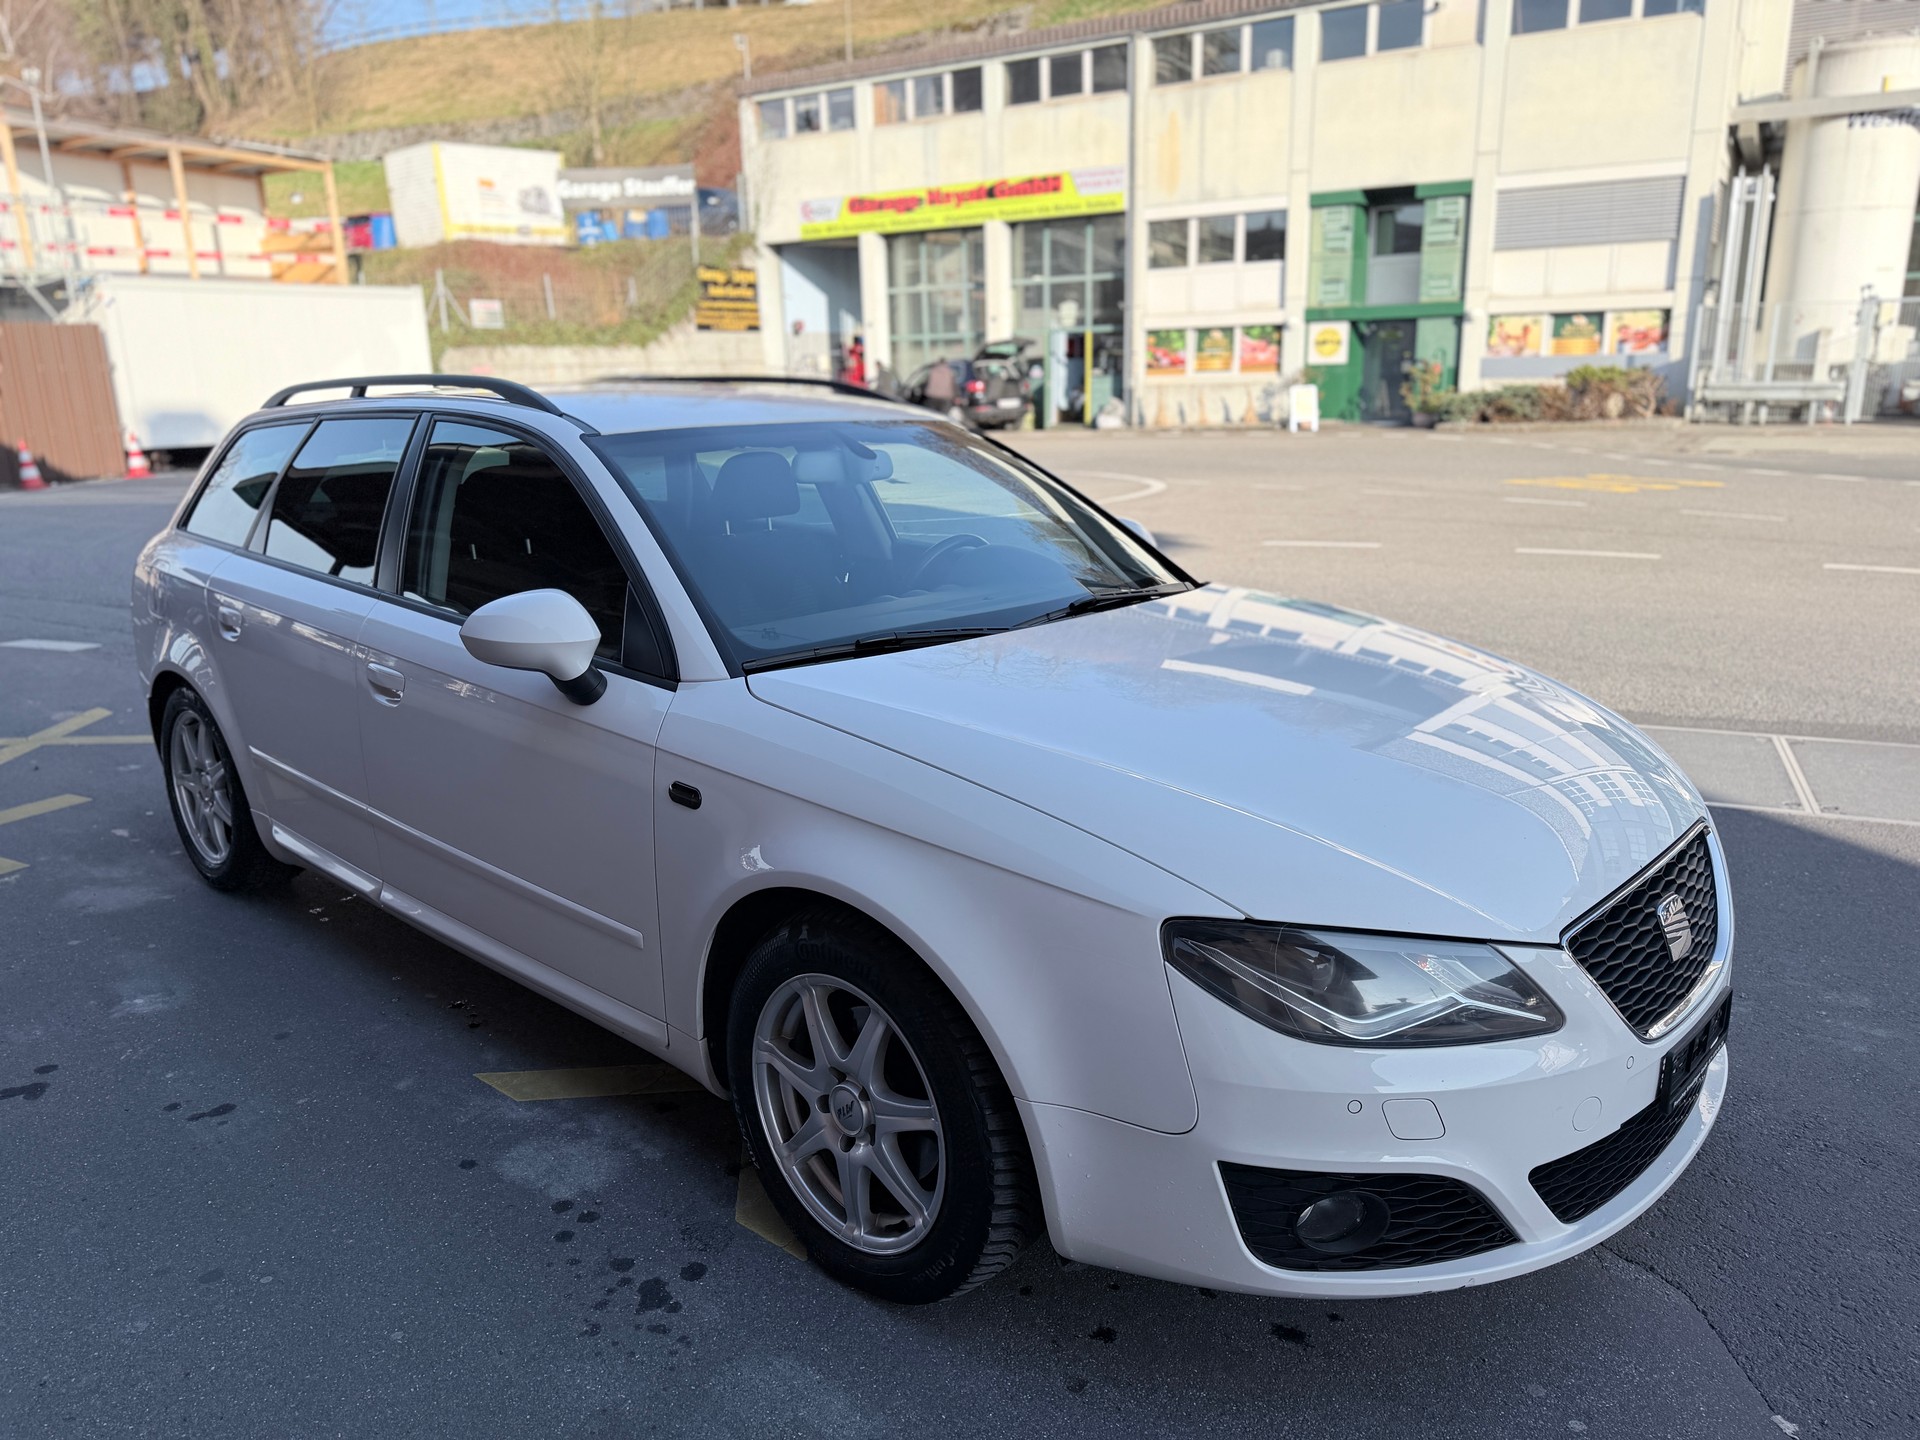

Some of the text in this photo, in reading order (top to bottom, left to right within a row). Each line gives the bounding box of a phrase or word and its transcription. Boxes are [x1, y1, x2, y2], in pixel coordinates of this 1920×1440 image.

[558, 175, 696, 202] Garage Stauffer
[848, 195, 921, 215] Garage
[993, 173, 1062, 198] GmbH
